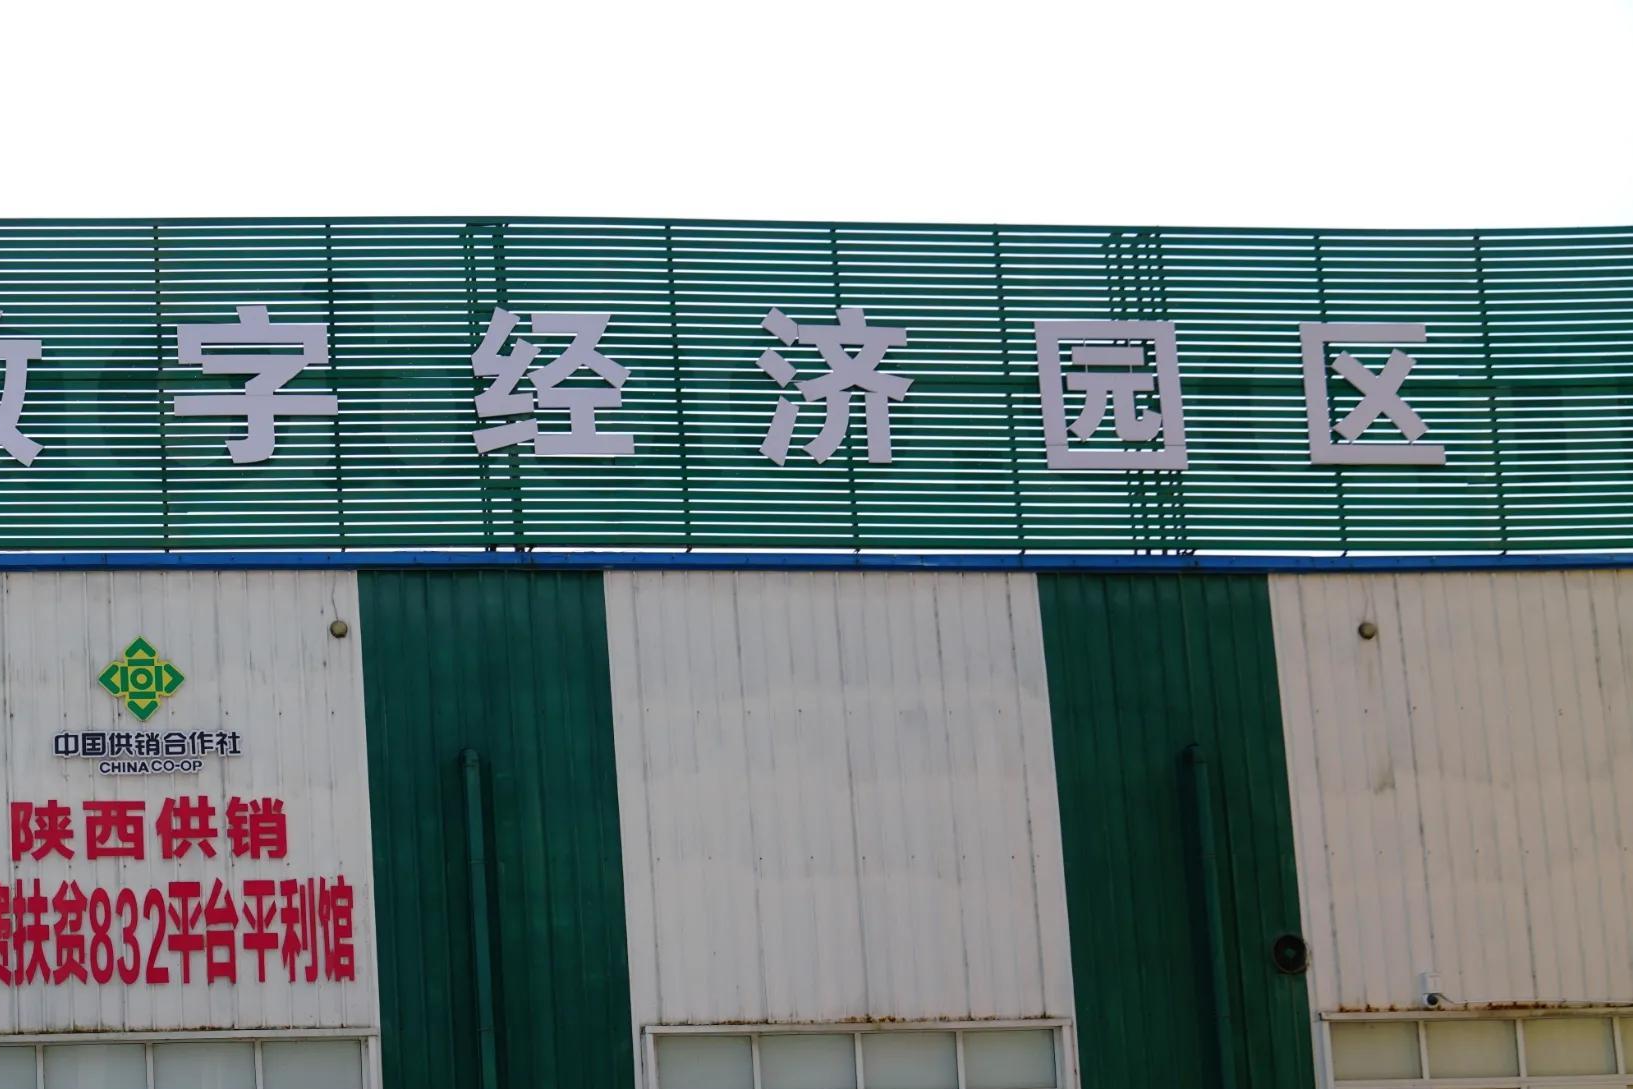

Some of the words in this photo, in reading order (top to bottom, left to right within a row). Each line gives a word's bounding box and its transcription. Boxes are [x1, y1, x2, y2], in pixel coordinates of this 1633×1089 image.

[53, 728, 243, 758] 中国供销合作社
[9, 795, 288, 862] 陕西供销
